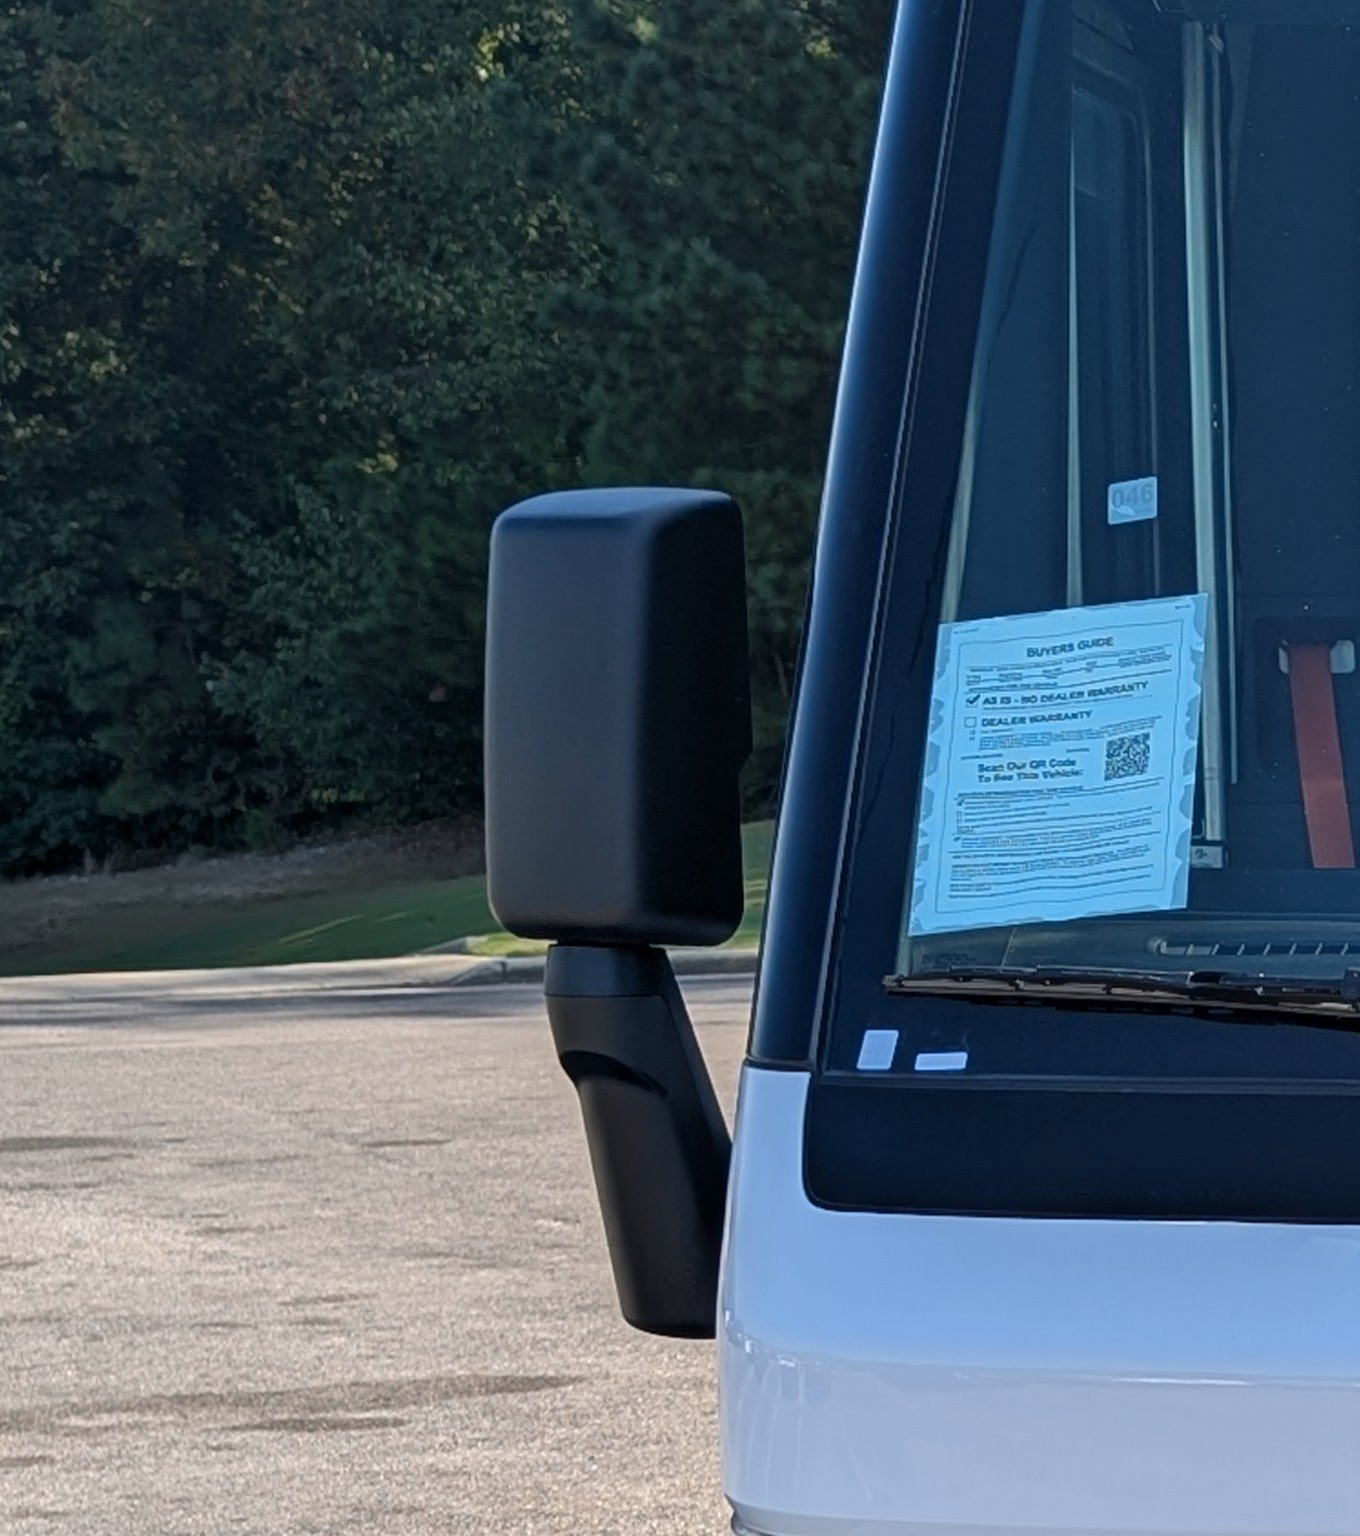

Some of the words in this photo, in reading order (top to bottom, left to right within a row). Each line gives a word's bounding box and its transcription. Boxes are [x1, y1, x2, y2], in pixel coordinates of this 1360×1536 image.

[1111, 483, 1153, 508] 046
[1026, 642, 1074, 657] BUYERS
[1077, 636, 1114, 650] GUIDE
[1020, 694, 1038, 704] NO
[1040, 690, 1085, 703] DEALER
[1087, 680, 1149, 697] WARRANTY
[981, 716, 1027, 727] DEALER
[1028, 709, 1093, 724] WARRANTY
[978, 764, 1004, 773] Scan
[1006, 761, 1027, 771] Our
[1029, 760, 1047, 769] QR
[1048, 758, 1076, 768] Code
[978, 774, 991, 783] To
[993, 773, 1013, 782] See
[1016, 771, 1039, 780] This
